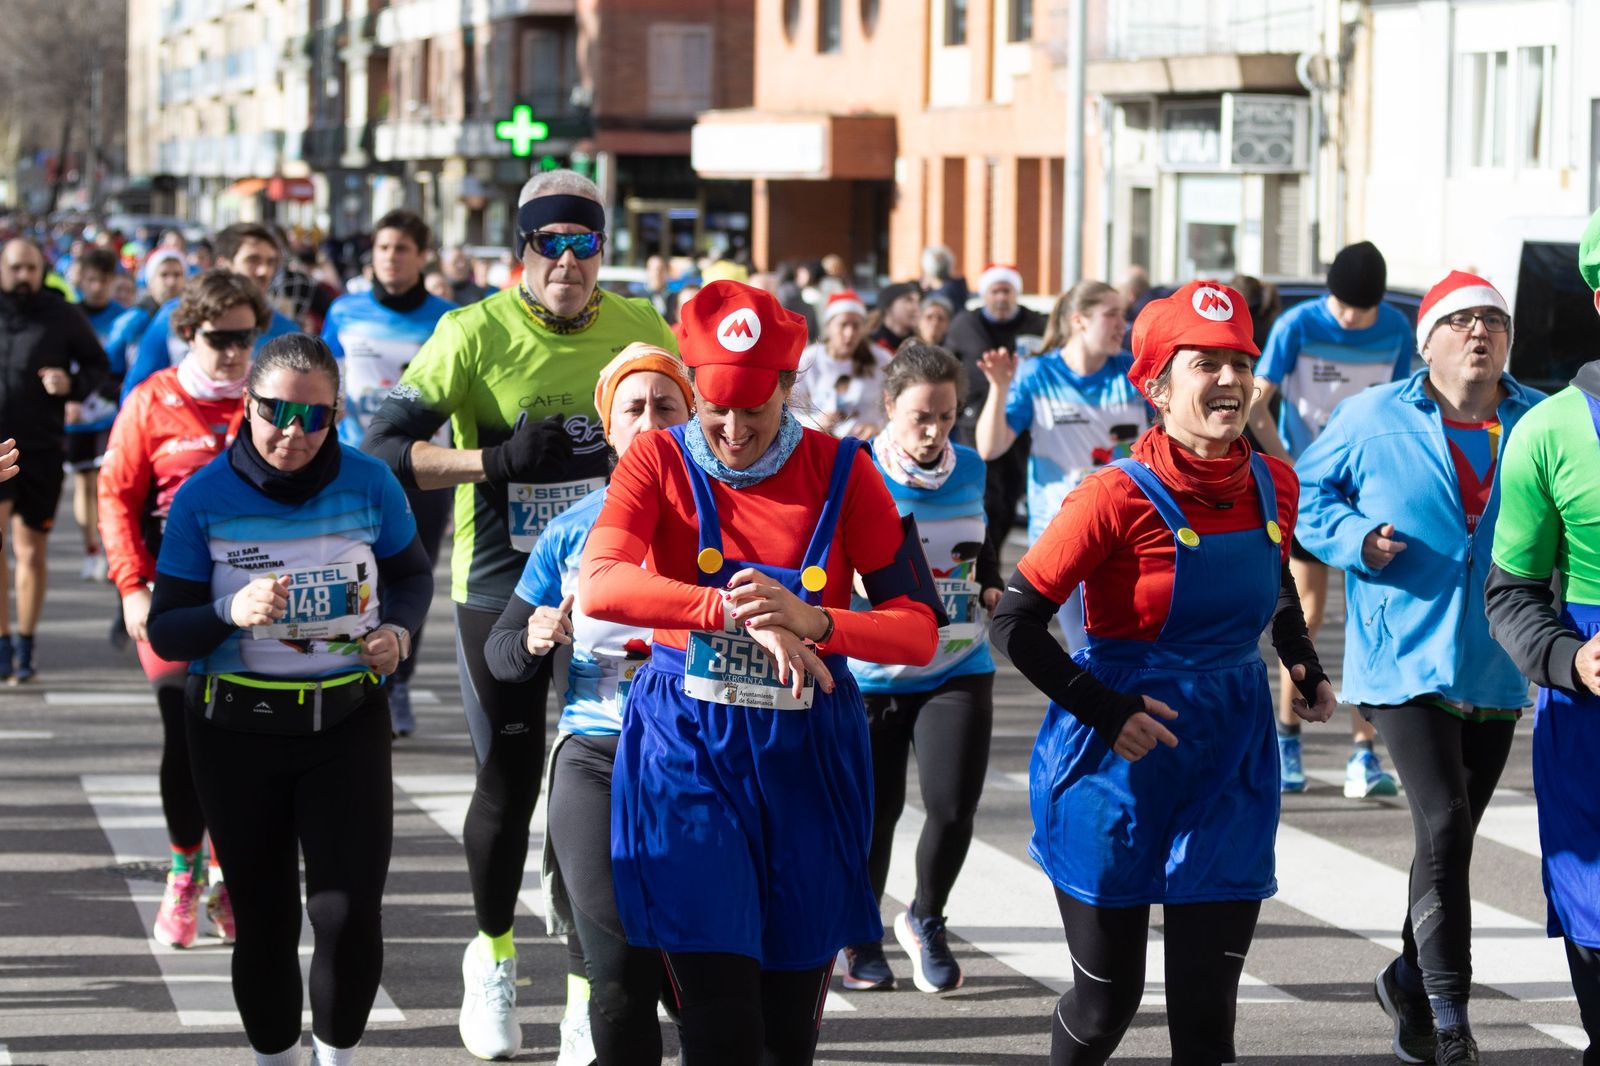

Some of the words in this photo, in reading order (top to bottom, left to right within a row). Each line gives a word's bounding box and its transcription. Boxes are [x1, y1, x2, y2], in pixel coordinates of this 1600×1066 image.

[1199, 293, 1230, 312] M
[723, 318, 754, 338] M
[242, 546, 259, 555] SAN
[228, 554, 269, 564] SILVESTRE
[283, 586, 331, 619] 148
[708, 637, 778, 680] 359
[721, 674, 764, 686] VIRGINIA
[739, 691, 774, 700] Ayuntamiento
[746, 699, 774, 707] Salamanca
